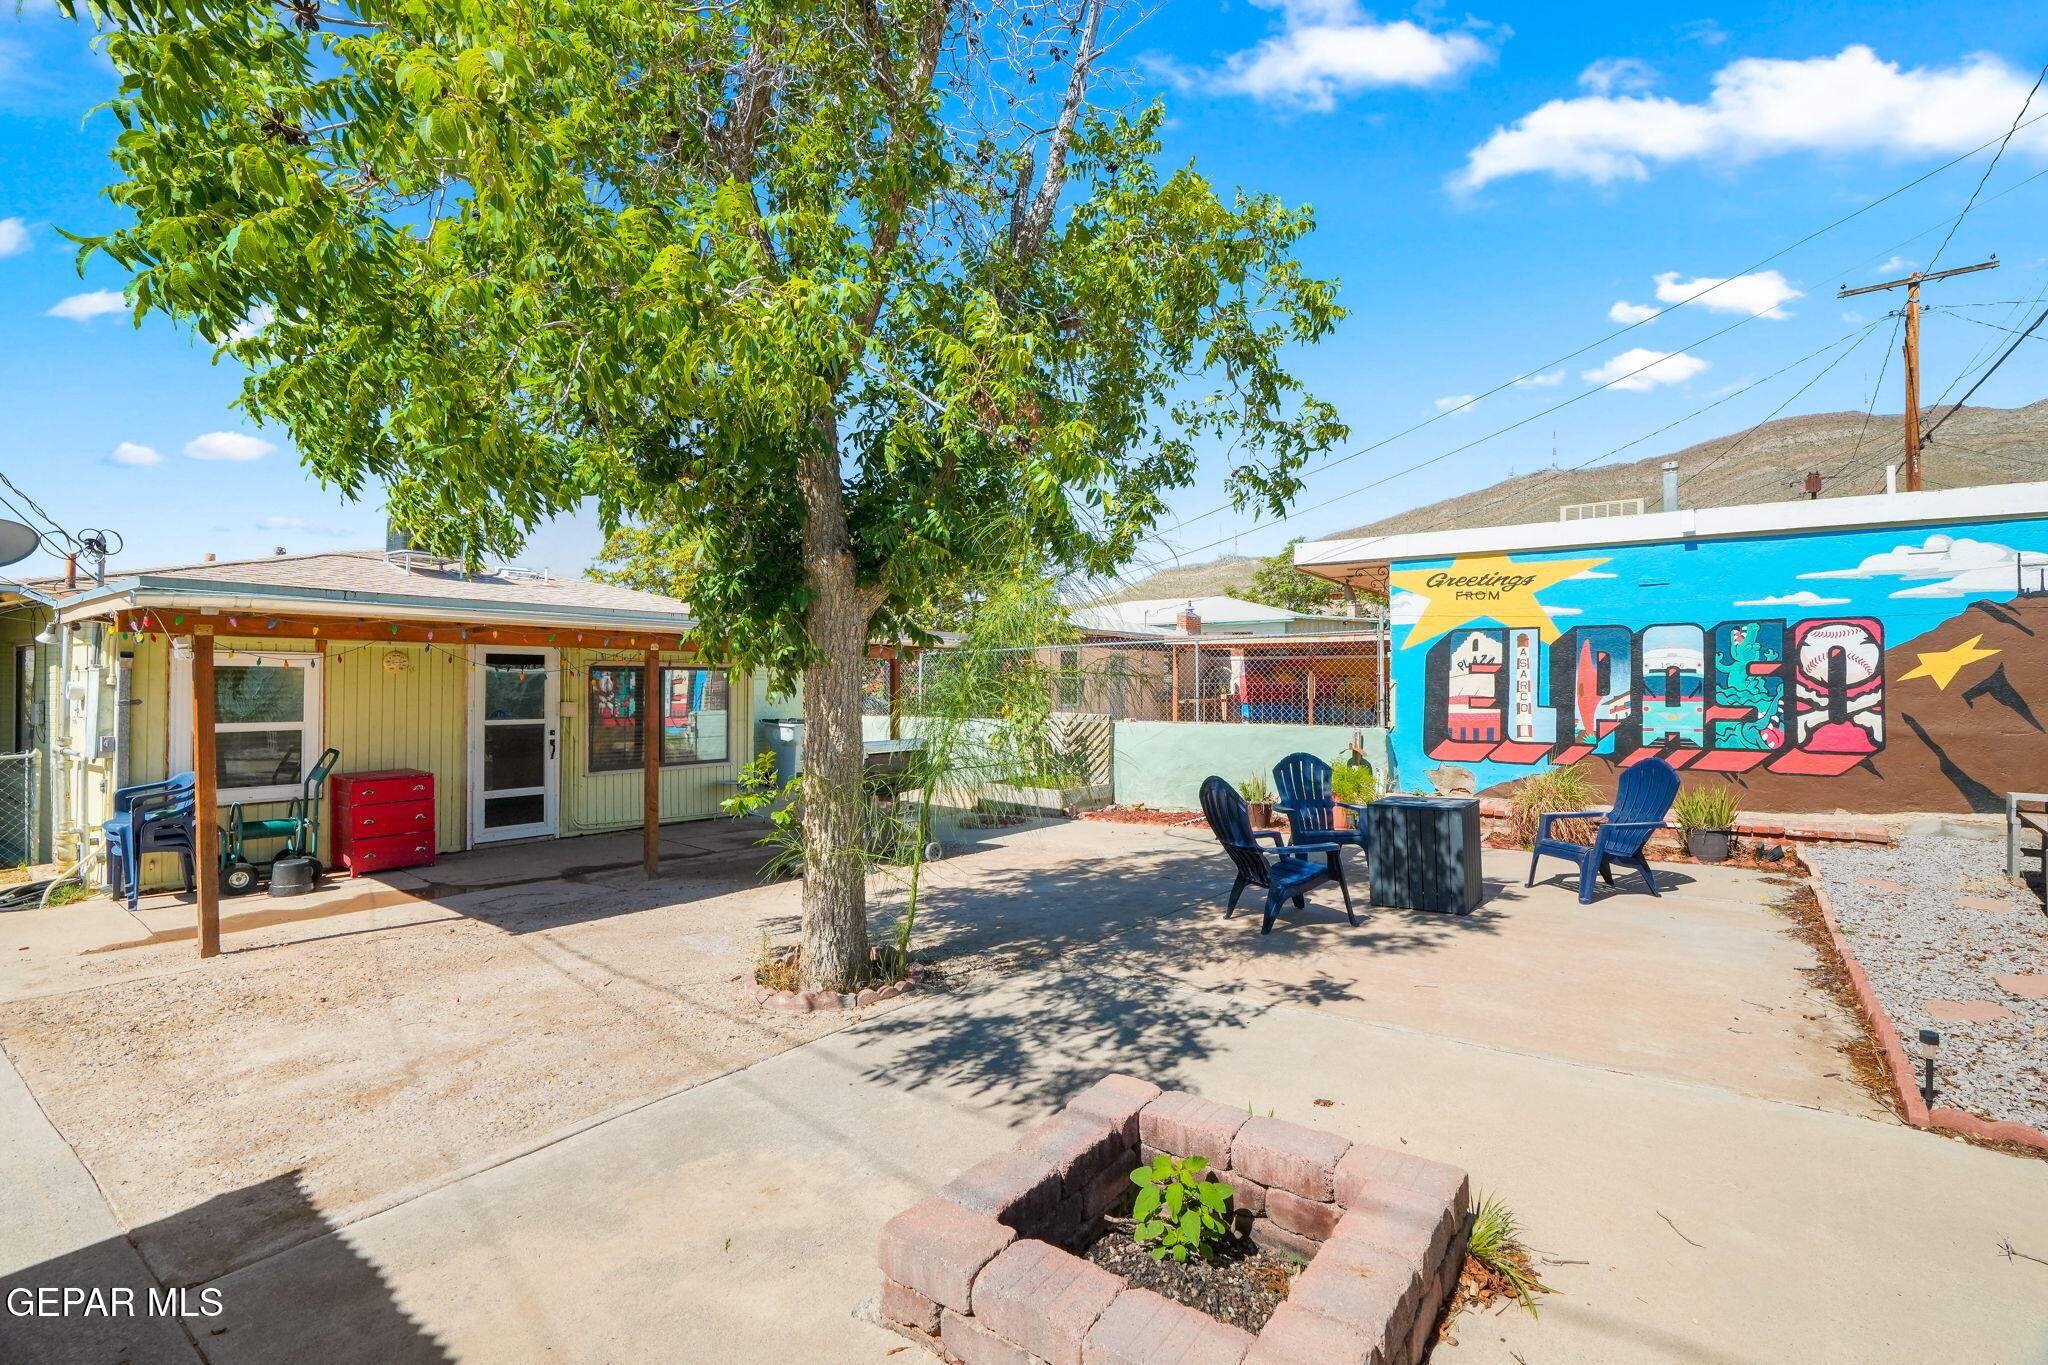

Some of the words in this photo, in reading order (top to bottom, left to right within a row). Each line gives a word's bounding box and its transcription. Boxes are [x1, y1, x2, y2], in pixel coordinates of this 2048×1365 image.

[1426, 571, 1536, 592] Greetings
[1455, 590, 1500, 601] FROM
[1457, 654, 1496, 671] PLAZA
[1519, 648, 1529, 713] ASARCO
[1424, 627, 1557, 764] EL
[1548, 616, 1886, 777] PASO
